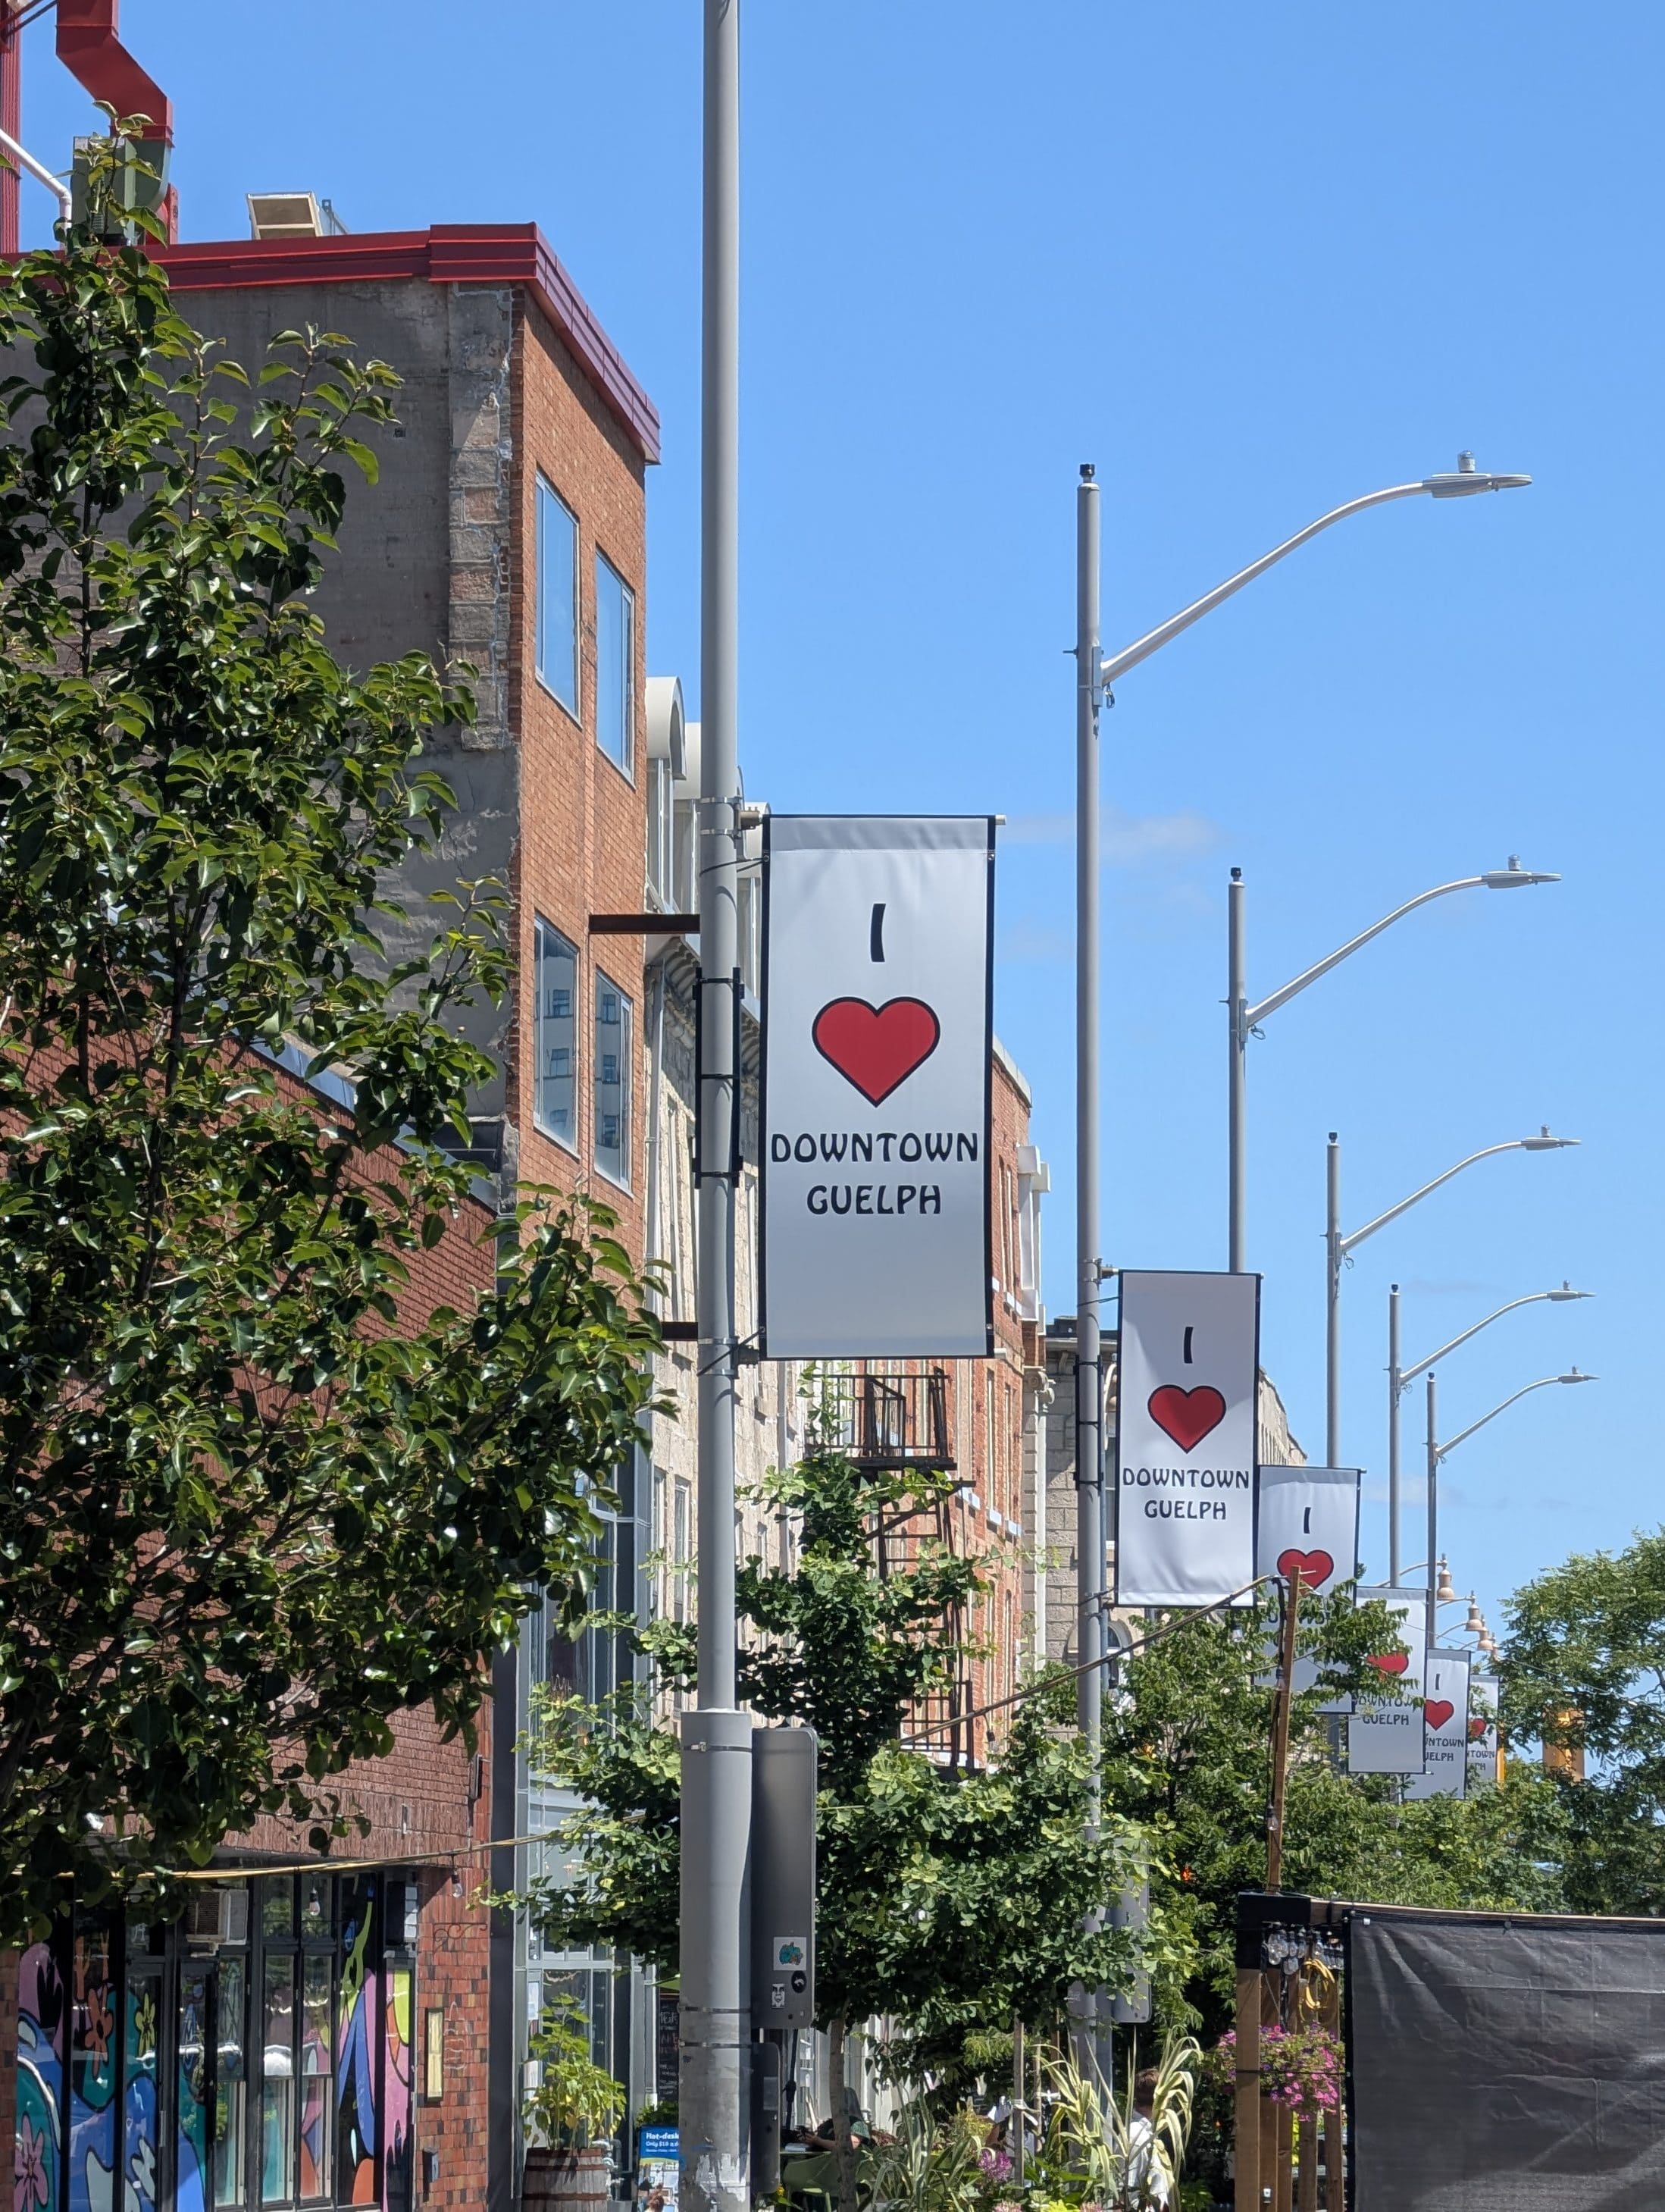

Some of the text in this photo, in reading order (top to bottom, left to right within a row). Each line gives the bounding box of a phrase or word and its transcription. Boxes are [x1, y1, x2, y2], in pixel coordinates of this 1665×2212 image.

[870, 903, 887, 963] I
[771, 1133, 978, 1163] DOWNTOWN
[806, 1185, 941, 1215] GUELPH
[1183, 1326, 1194, 1364] I
[1122, 1468, 1250, 1490] DOWNTOWN
[1144, 1499, 1226, 1520] GUELPH
[1303, 1506, 1311, 1534] I
[1435, 1673, 1440, 1690] I
[1362, 1714, 1410, 1726] GUELPH
[1426, 1737, 1465, 1747] NTOWN
